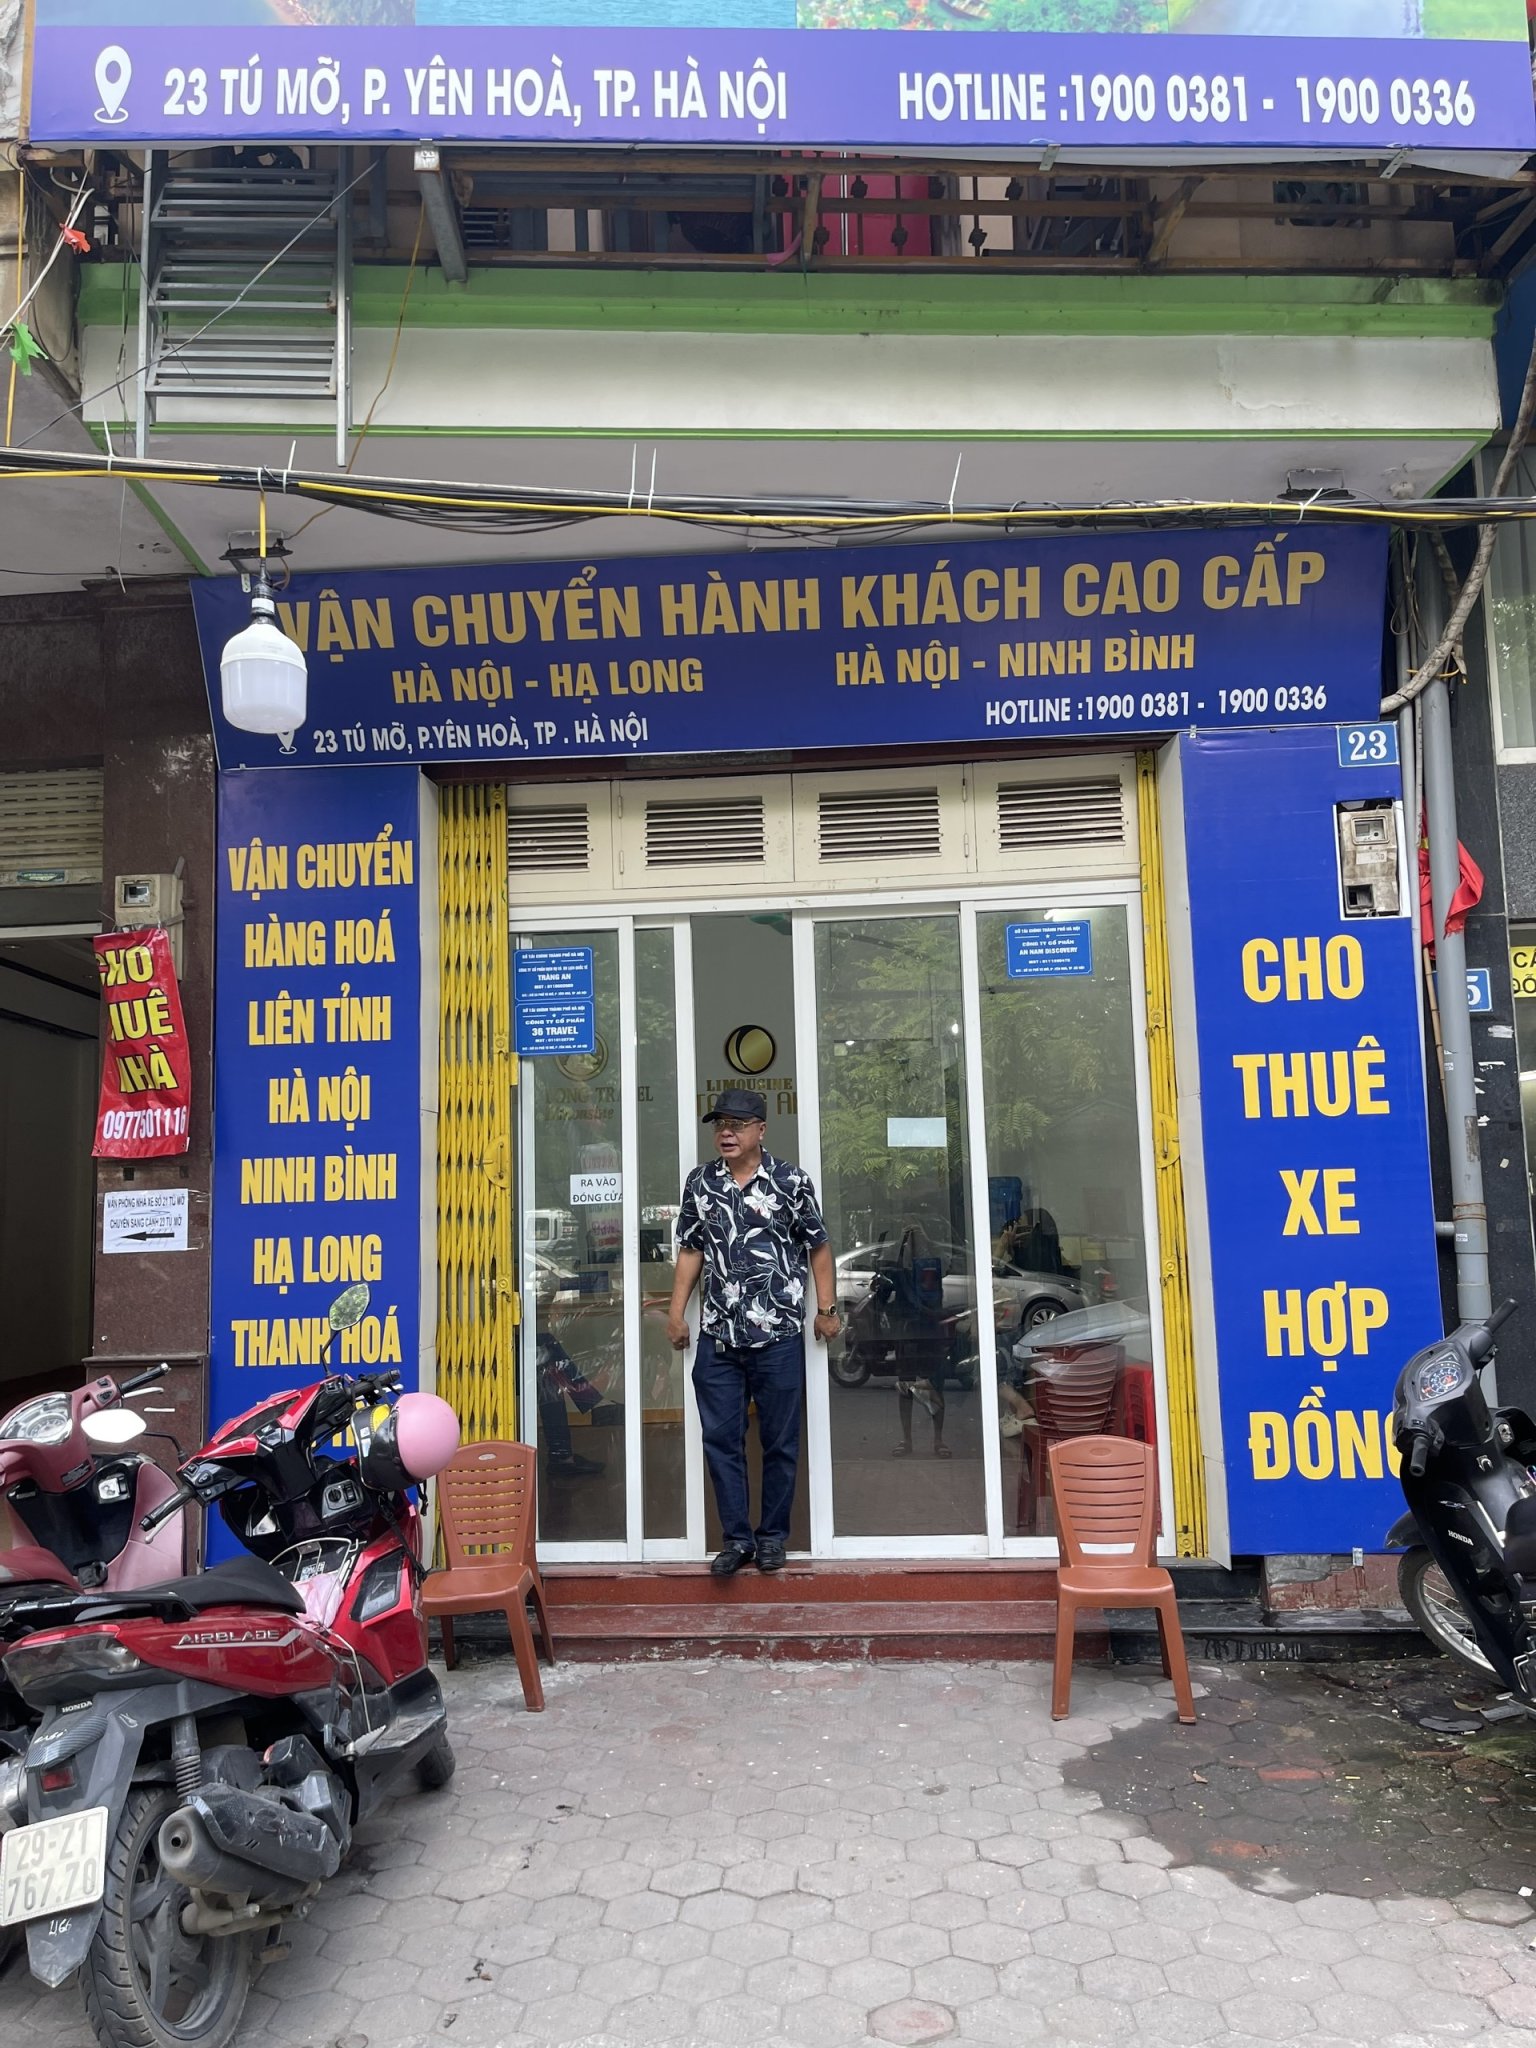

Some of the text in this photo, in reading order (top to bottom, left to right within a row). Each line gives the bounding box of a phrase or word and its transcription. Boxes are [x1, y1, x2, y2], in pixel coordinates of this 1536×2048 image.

[164, 54, 787, 134] 23 TÚ MỠ, P. YÊN HOÀ, TP. HÀ NỘI
[899, 72, 1046, 121] HOTLINE
[1059, 74, 1156, 122] :1900
[1166, 76, 1248, 122] 0381
[1296, 77, 1379, 125] 1900
[1391, 78, 1476, 126] 0336
[277, 532, 1326, 662] VẬN CHUYỂN HÀNH KHÁCH CAO CẤP
[392, 657, 704, 708] HÀ NỘI - HẠ LONG
[835, 629, 1196, 689] HÀ NỘI - NINH BÌNH
[313, 729, 338, 754] 23
[341, 721, 366, 753] TÚ
[373, 721, 413, 757] MỠ,
[477, 715, 529, 753] HOÀ,
[533, 721, 557, 747] TP
[574, 715, 604, 744] HÀ
[610, 711, 648, 749] NỘI
[986, 697, 1071, 726] HOTLINE
[1140, 691, 1190, 719] 0381
[1218, 687, 1270, 714] 1900
[1274, 685, 1327, 712] 0336
[1348, 730, 1387, 762] 23
[228, 823, 414, 901] VẬN CHUYỂN
[245, 908, 396, 968] HÀNG HOÁ
[1045, 946, 1078, 955] DISCOVERY
[1242, 934, 1364, 1003] CHO
[249, 982, 391, 1045] LIÊN TỈNH
[532, 1026, 579, 1036] 36 TRAVEL
[269, 1065, 370, 1132] HÀ NỘI
[595, 1085, 654, 1104] TREL
[706, 1078, 793, 1091] LIMOUSINE
[1233, 1035, 1390, 1119] THUÊ
[240, 1145, 397, 1204] NINH BÌNH
[572, 1192, 602, 1203] ĐÓNG
[580, 1176, 617, 1187] RA VÀO
[1279, 1167, 1361, 1236] XE
[253, 1233, 382, 1294] HẠ LONG
[231, 1305, 402, 1367] THANH HOÁ
[1263, 1281, 1389, 1372] HỢP
[1448, 1529, 1474, 1546] HONDA
[178, 1630, 280, 1645] AIRBLADE
[61, 1700, 93, 1714] HONDA
[17, 1817, 88, 1872] 29-Z1
[8, 1858, 97, 1917] 767.70
